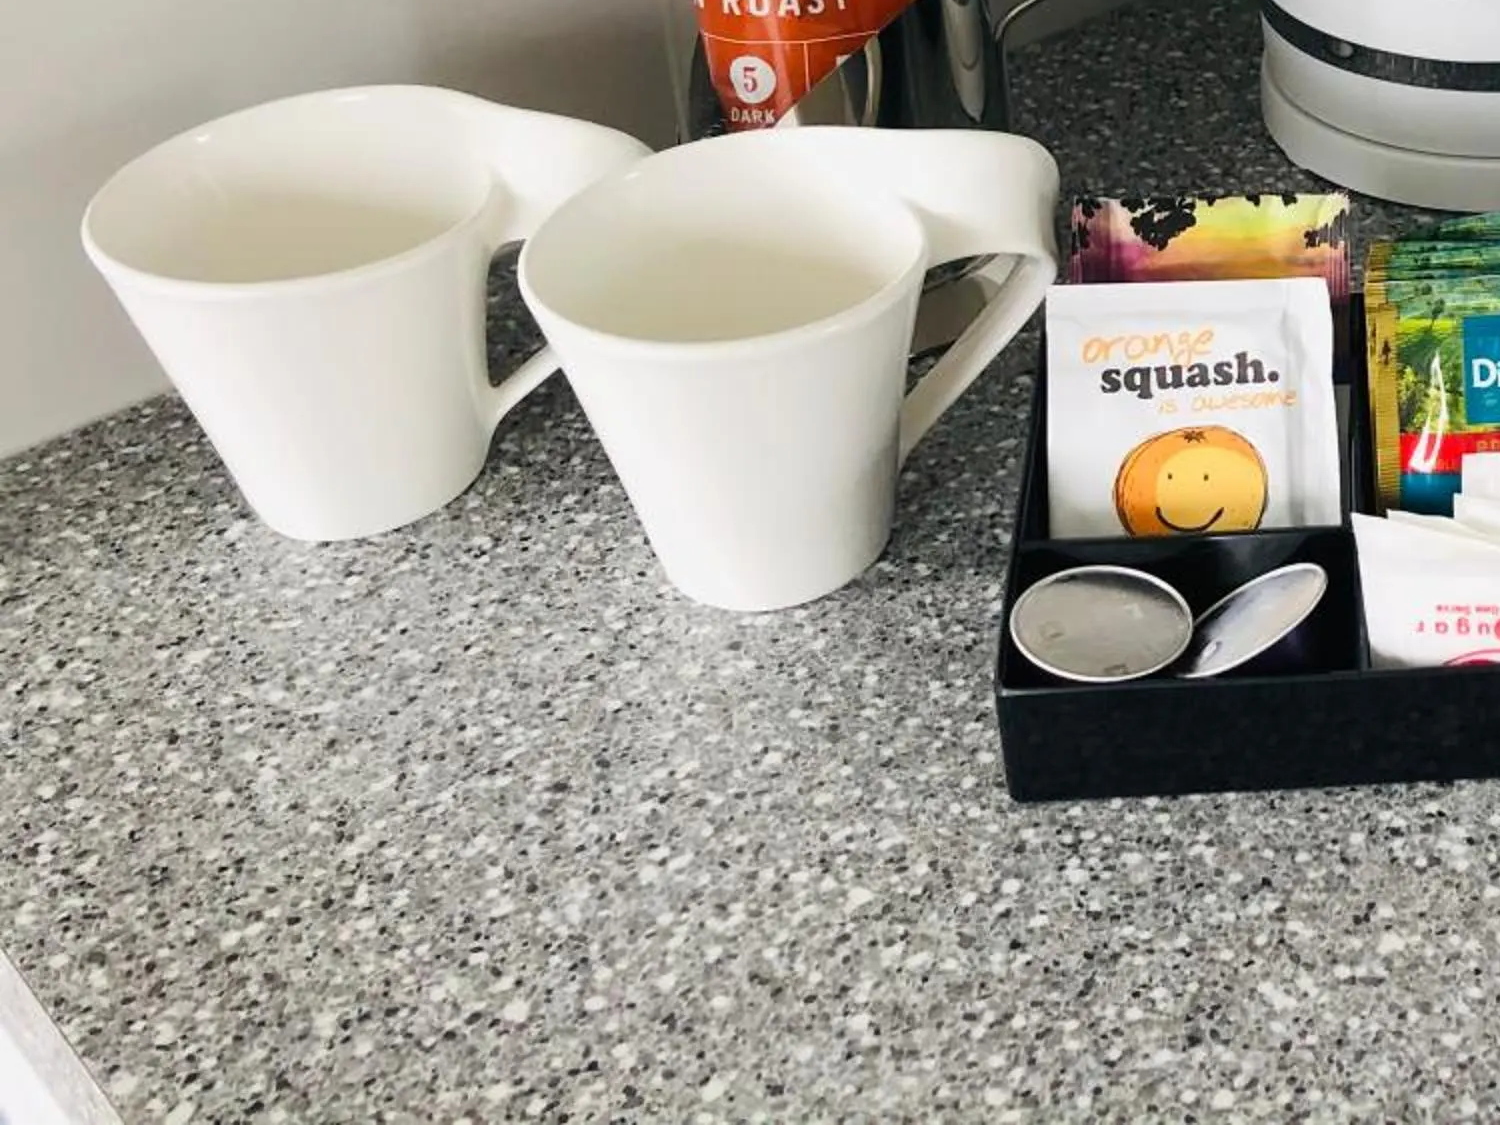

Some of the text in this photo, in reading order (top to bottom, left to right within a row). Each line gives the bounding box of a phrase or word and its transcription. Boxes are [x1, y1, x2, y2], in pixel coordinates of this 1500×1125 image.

[743, 65, 759, 94] 5
[731, 106, 776, 124] DARK
[1082, 326, 1215, 365] orange
[1100, 350, 1280, 400] squash.
[1190, 388, 1297, 413] awesome
